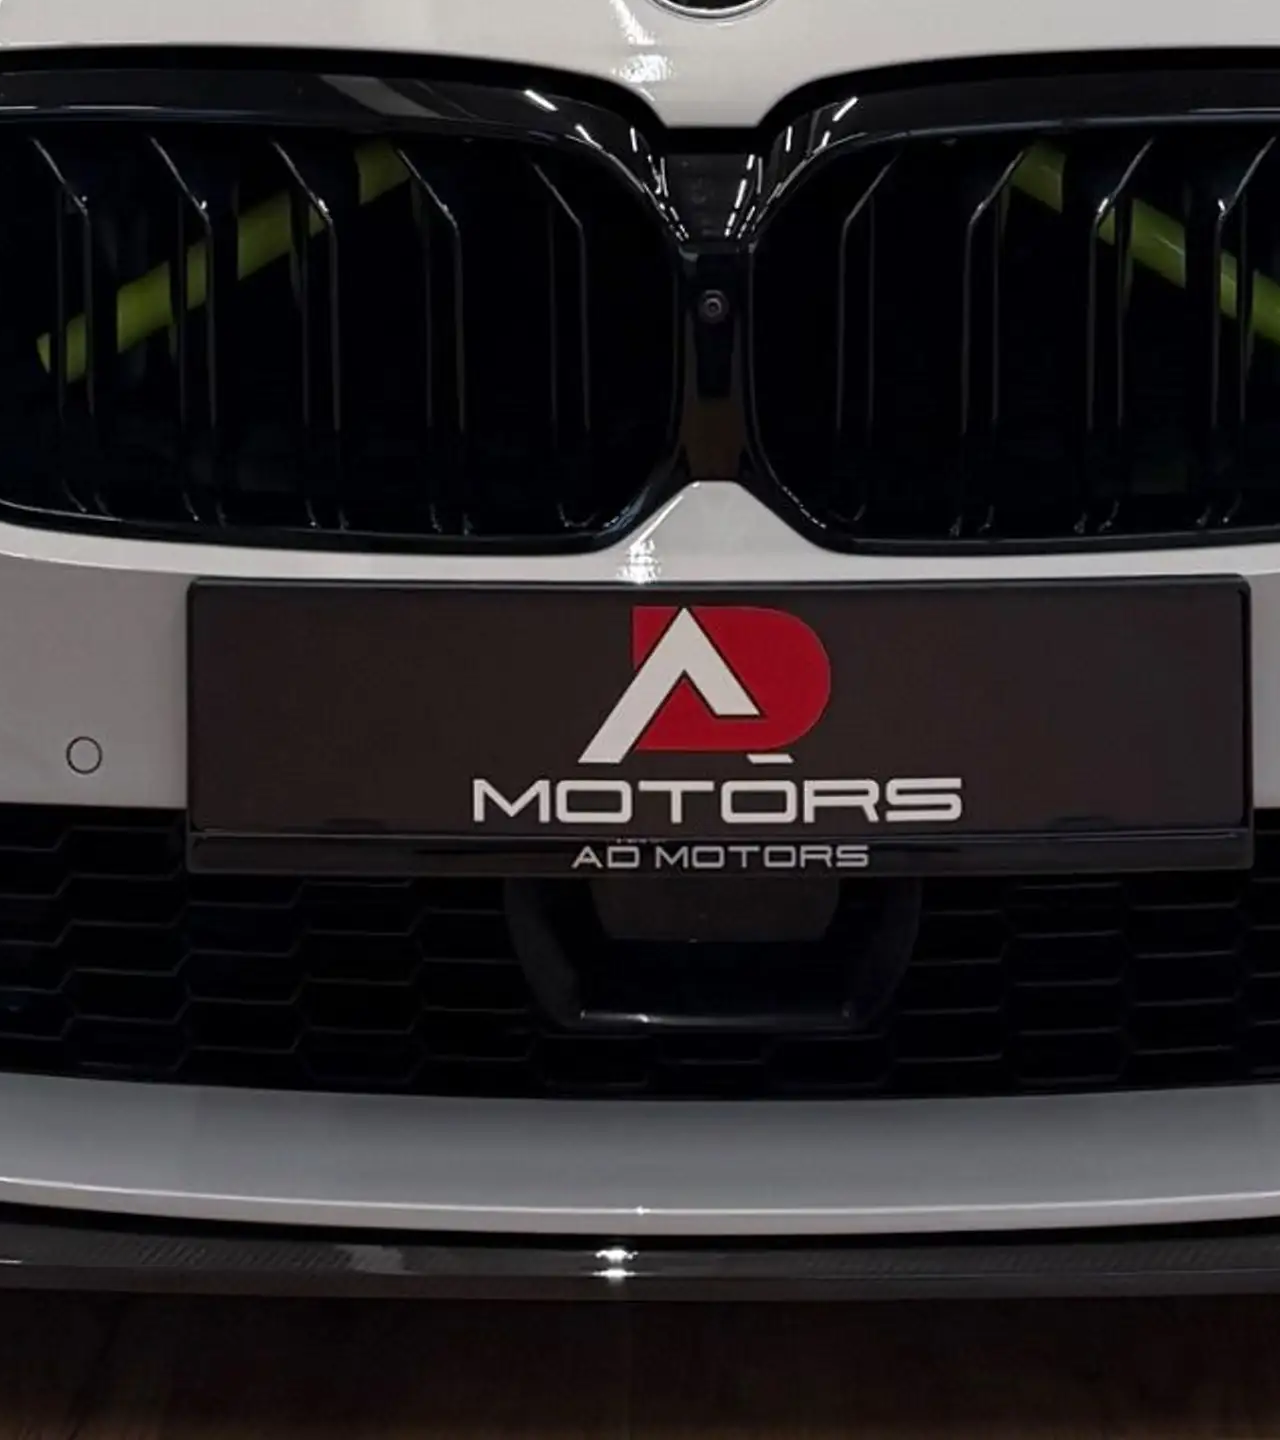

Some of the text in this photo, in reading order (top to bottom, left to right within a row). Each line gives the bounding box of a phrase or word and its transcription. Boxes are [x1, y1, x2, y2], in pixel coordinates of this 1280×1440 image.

[472, 776, 963, 824] MOTORS
[571, 844, 870, 869] AD MOTORS
